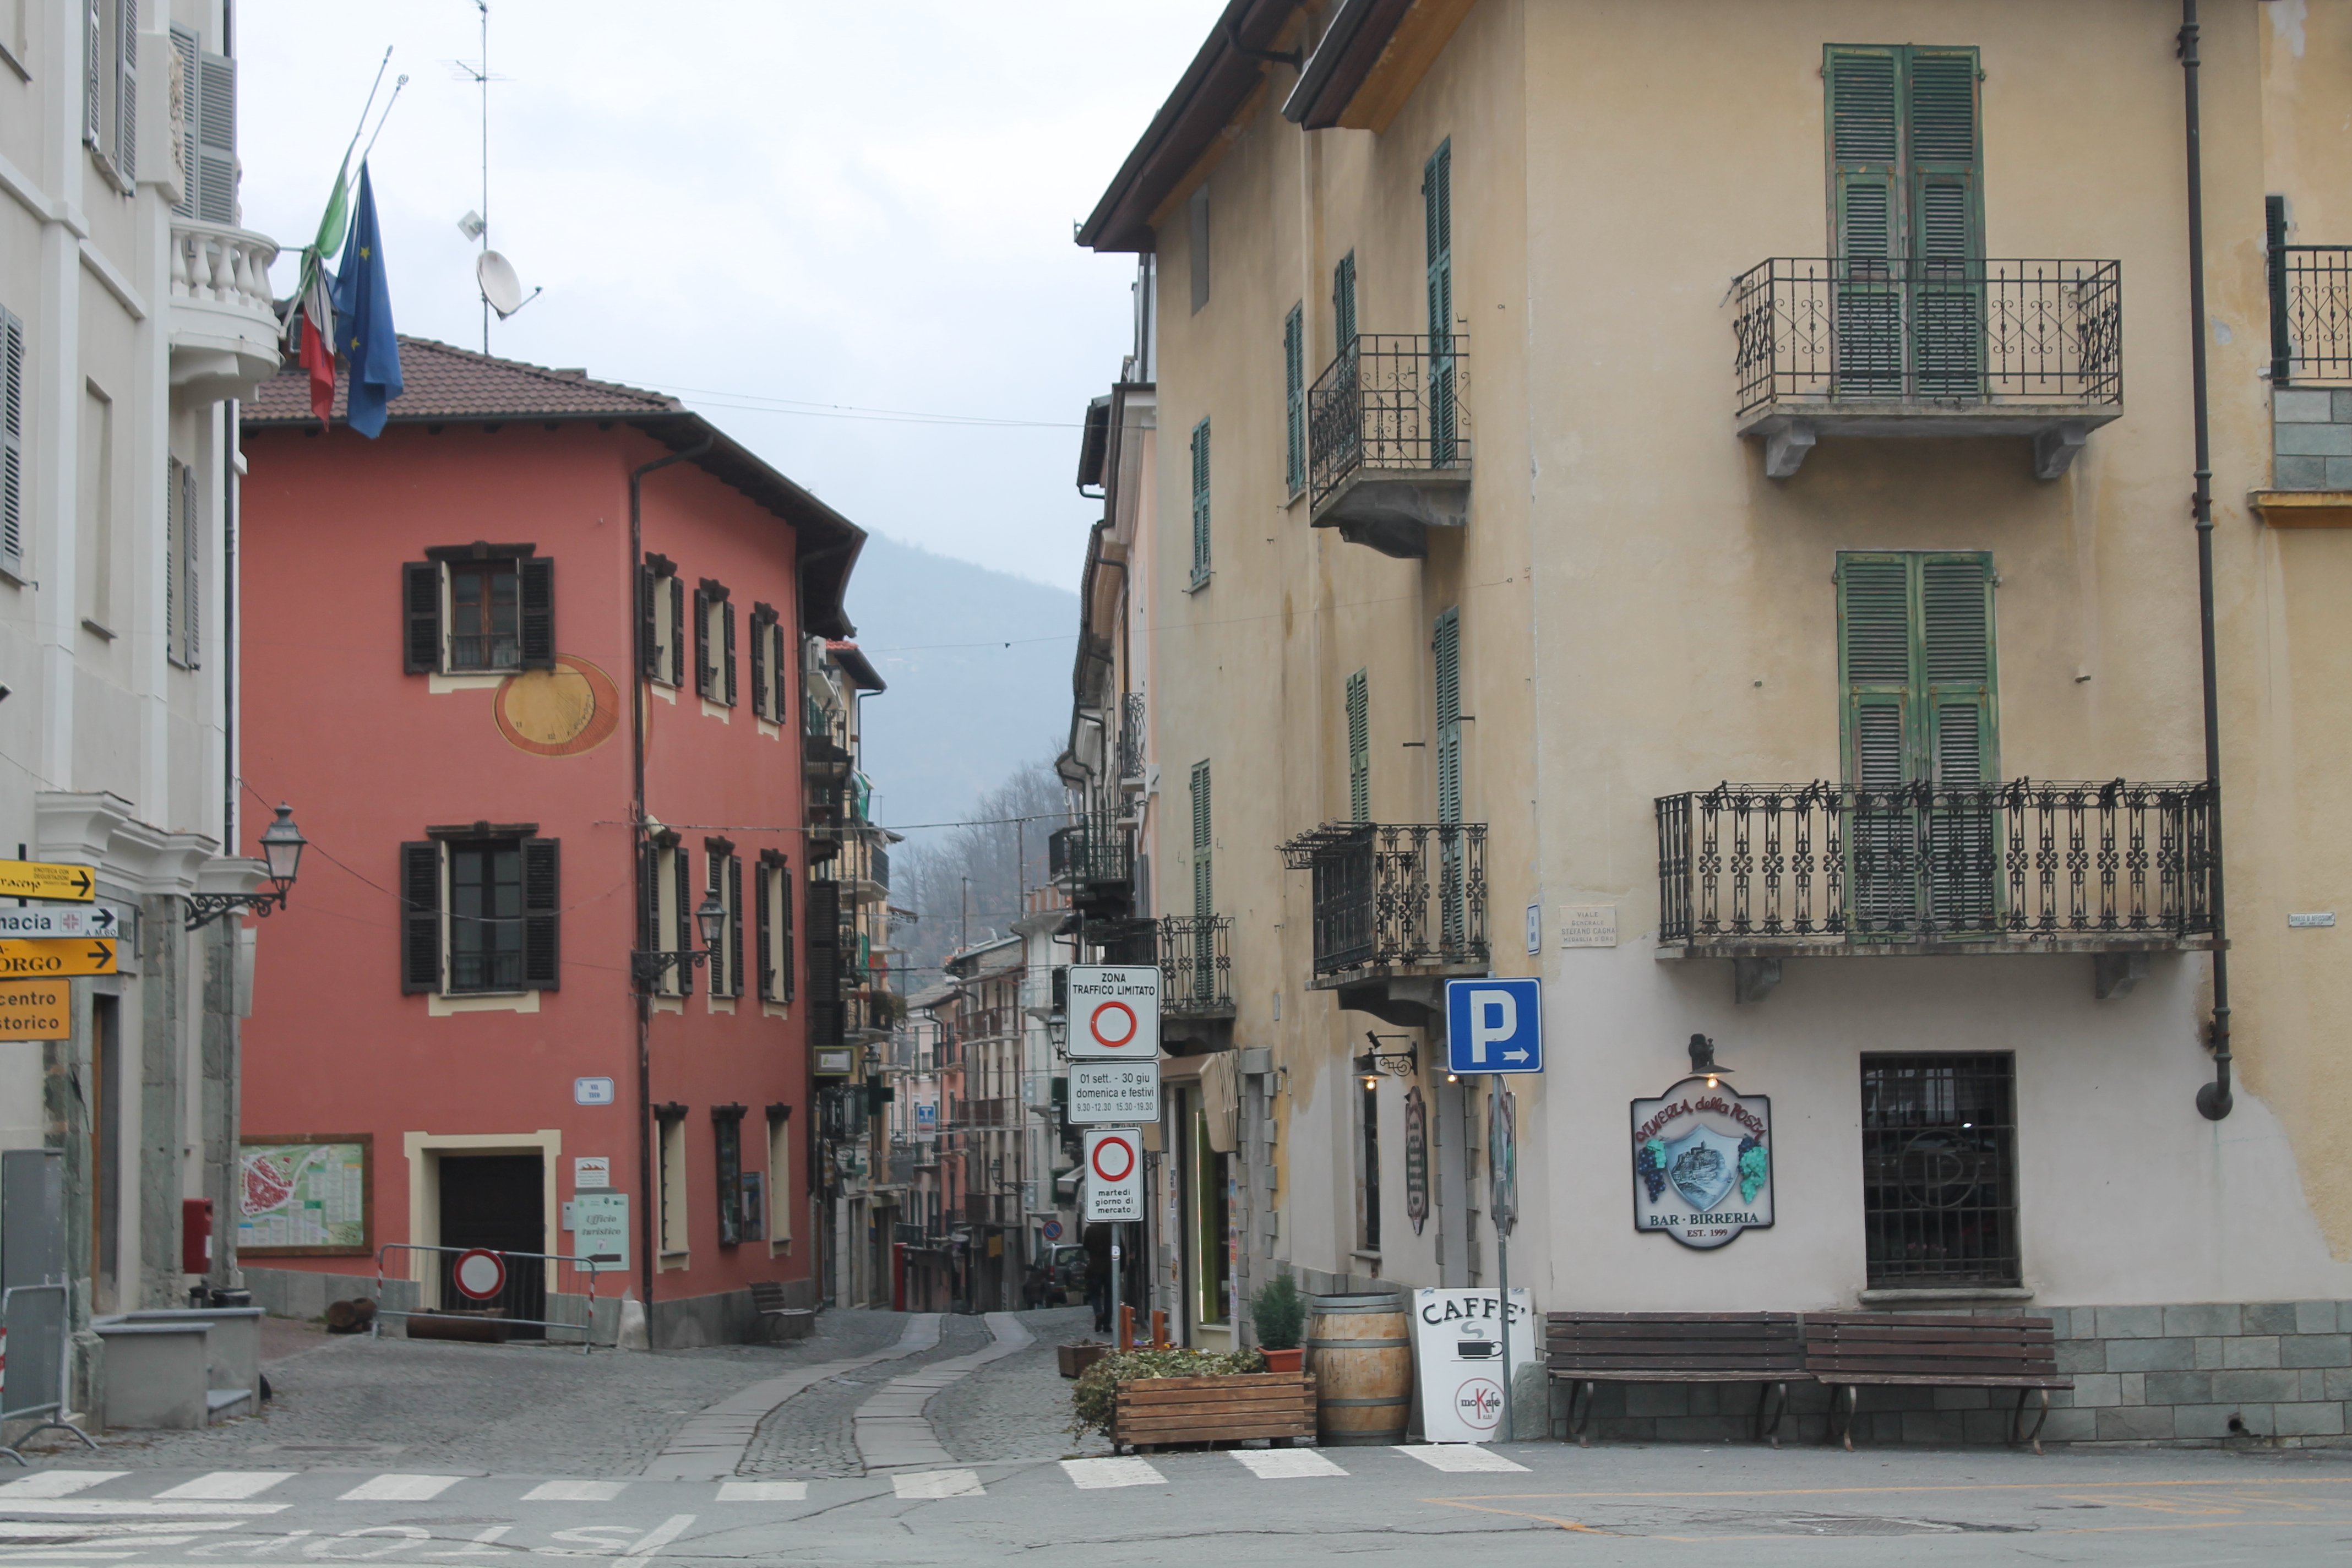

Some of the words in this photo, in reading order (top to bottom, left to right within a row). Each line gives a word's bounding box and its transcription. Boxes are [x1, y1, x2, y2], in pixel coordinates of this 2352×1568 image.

[1102, 973, 1126, 982] ZONA
[1073, 984, 1114, 995] TRAFFICO
[1118, 986, 1155, 995] LIMITATO
[1471, 990, 1517, 1063] P
[1080, 1074, 1090, 1084] 01
[1093, 1074, 1111, 1084] sett.
[1122, 1073, 1133, 1083] 30
[1136, 1073, 1150, 1085] giu
[1077, 1088, 1118, 1098] domenica
[1129, 1087, 1154, 1097] festivi
[1636, 1099, 1694, 1142] VINERIA
[1695, 1096, 1730, 1114] della
[1730, 1103, 1767, 1140] POSTA
[1096, 1199, 1121, 1207] giorno
[586, 1214, 617, 1225] Ufficio
[1649, 1215, 1679, 1226] BAR
[1689, 1213, 1758, 1225] BIRRERIA
[581, 1227, 622, 1235] turistico
